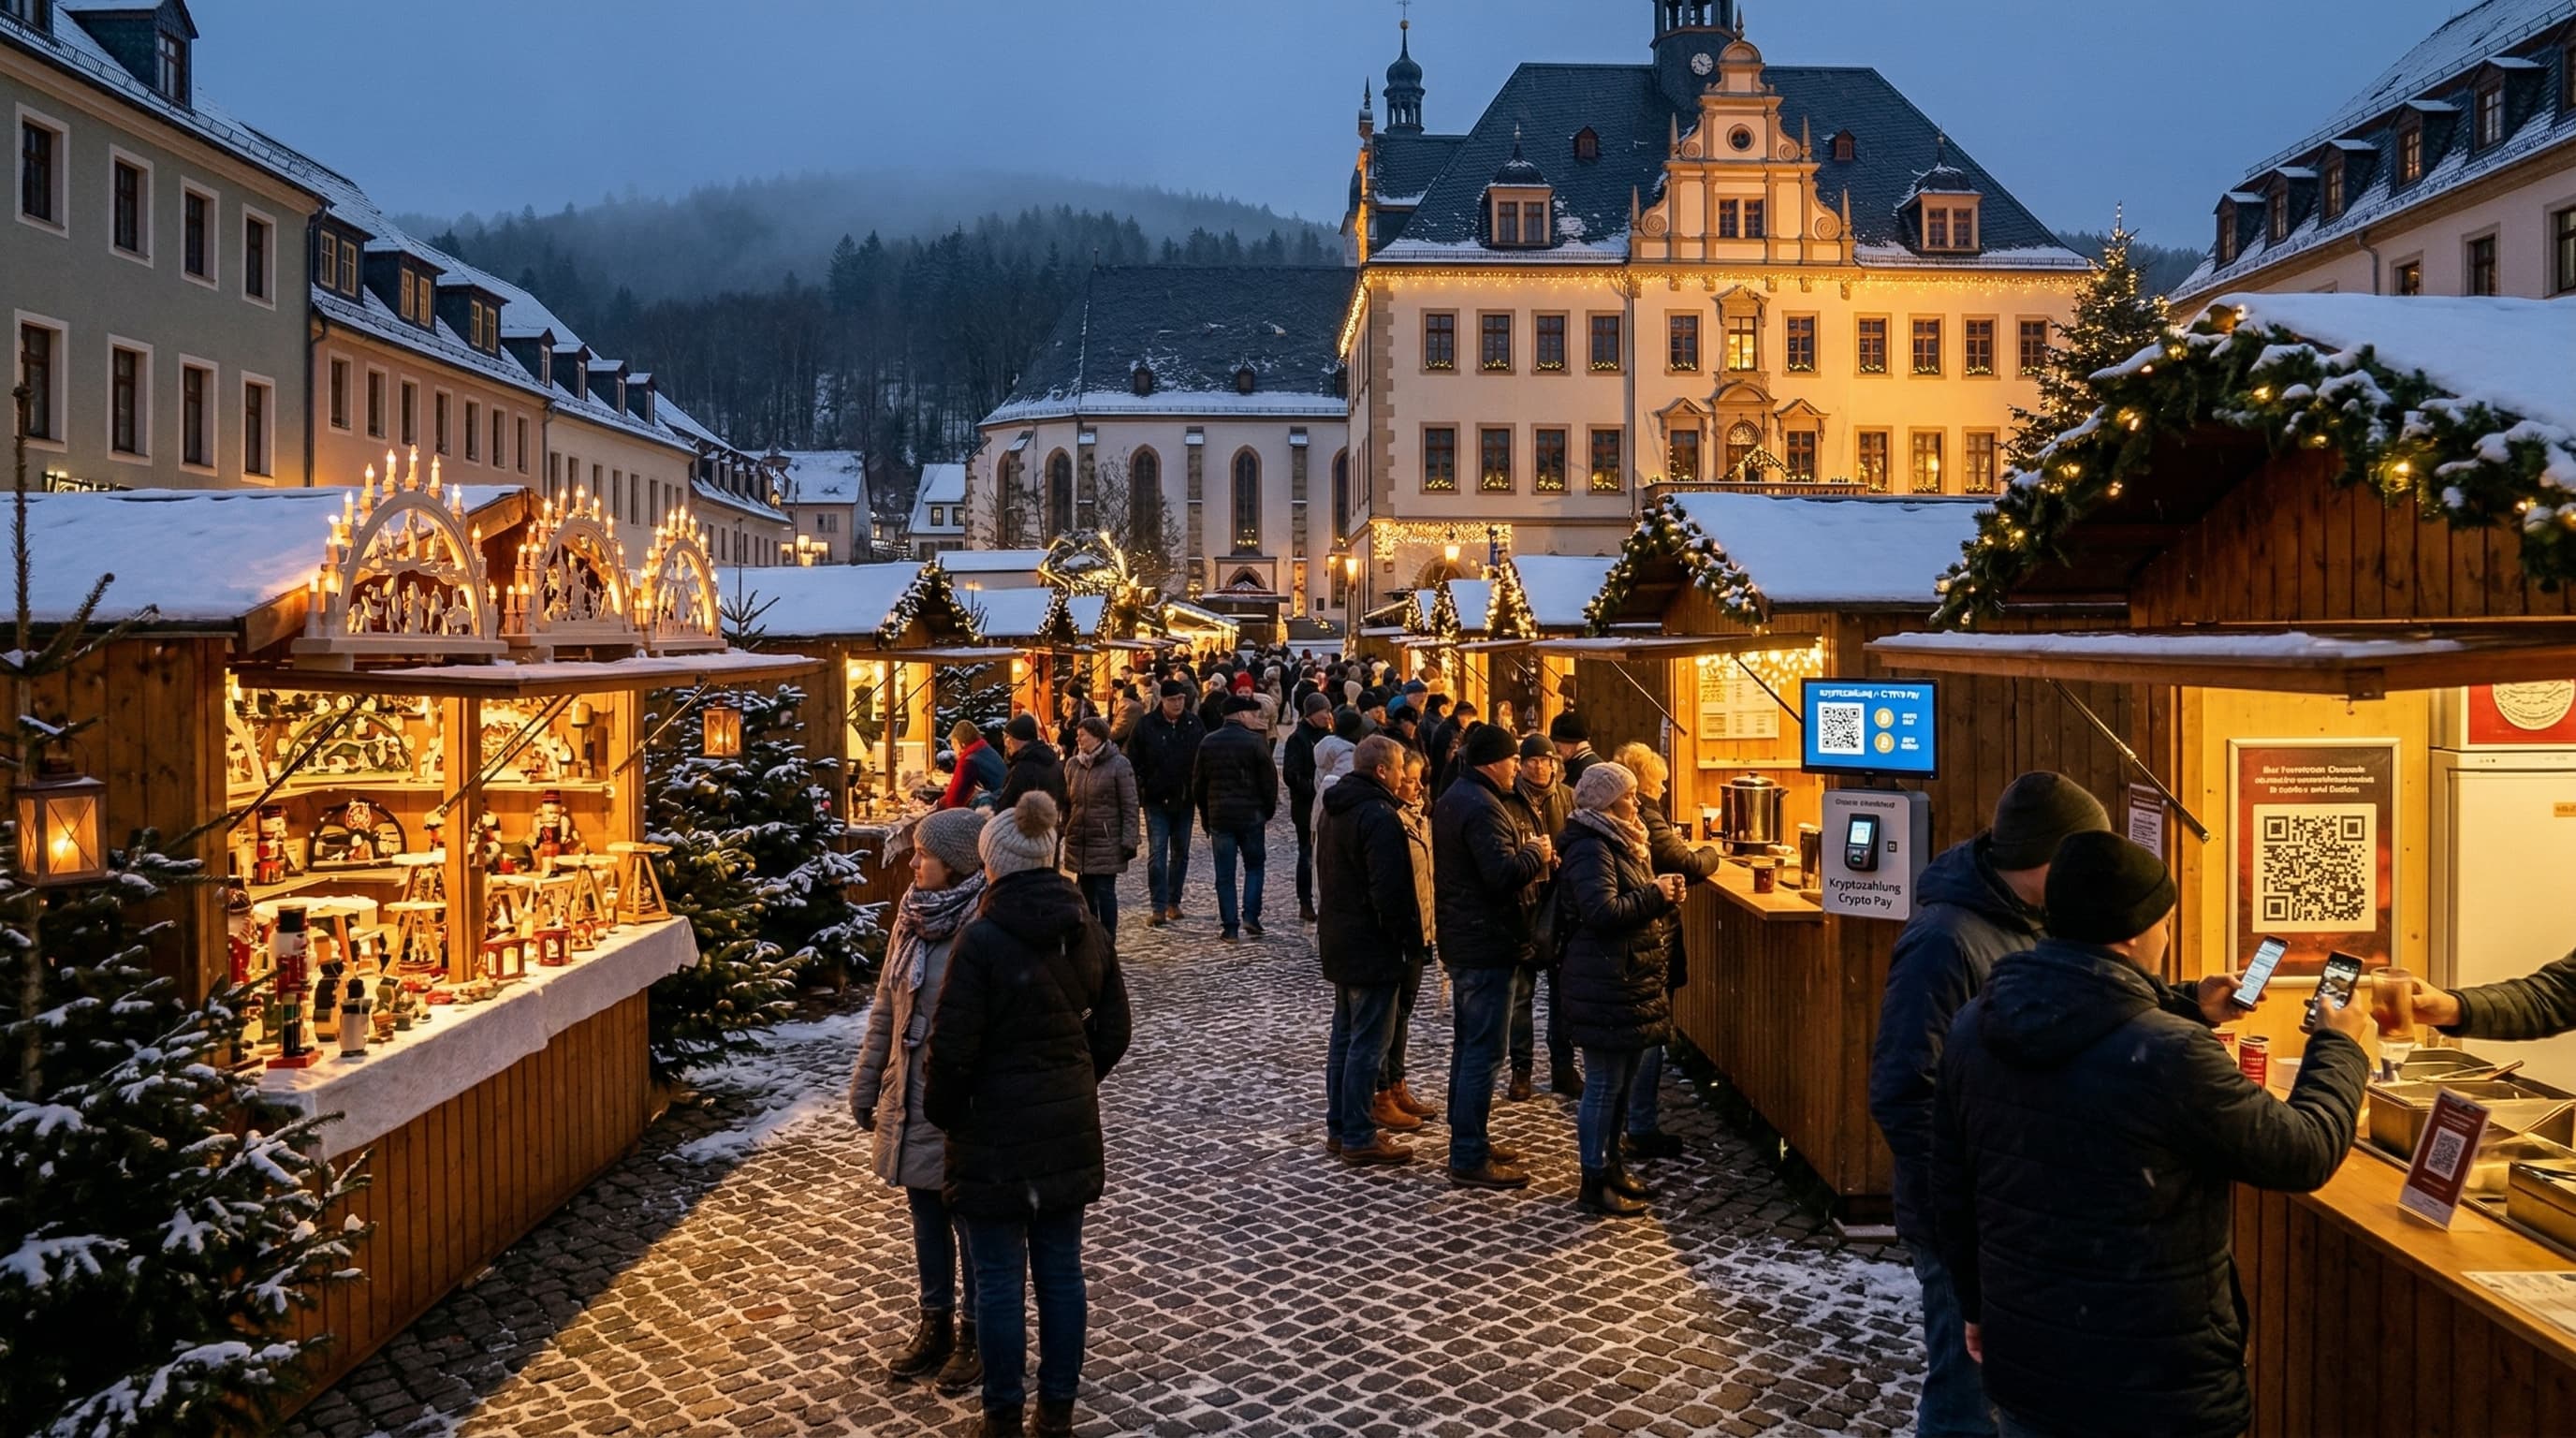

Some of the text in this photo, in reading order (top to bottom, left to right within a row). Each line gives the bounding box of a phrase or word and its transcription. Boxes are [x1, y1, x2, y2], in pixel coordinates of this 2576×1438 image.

[1829, 878, 1901, 896] Kryptozahlung
[1838, 892, 1893, 910] Crypto Pay
